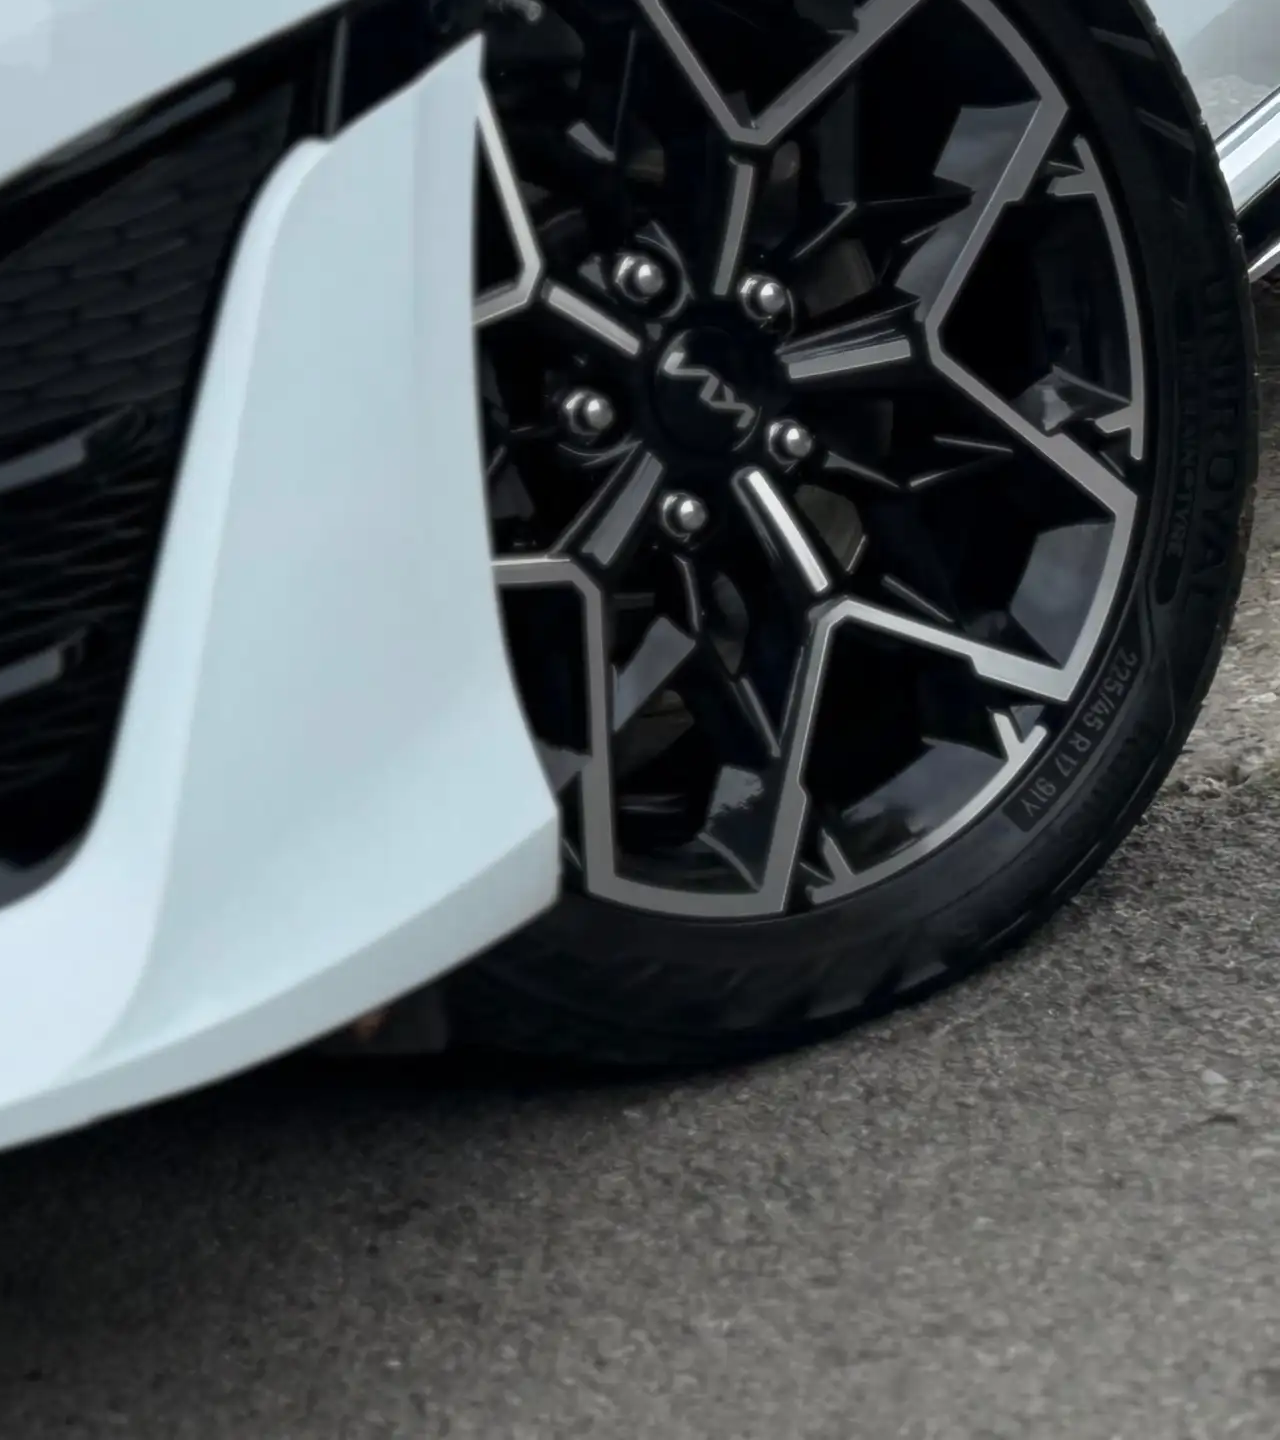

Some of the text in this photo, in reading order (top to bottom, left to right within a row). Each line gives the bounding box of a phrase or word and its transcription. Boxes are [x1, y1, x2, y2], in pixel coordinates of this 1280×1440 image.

[1081, 645, 1139, 731] 225/45
[1068, 732, 1092, 753] R
[1054, 750, 1079, 778] 17
